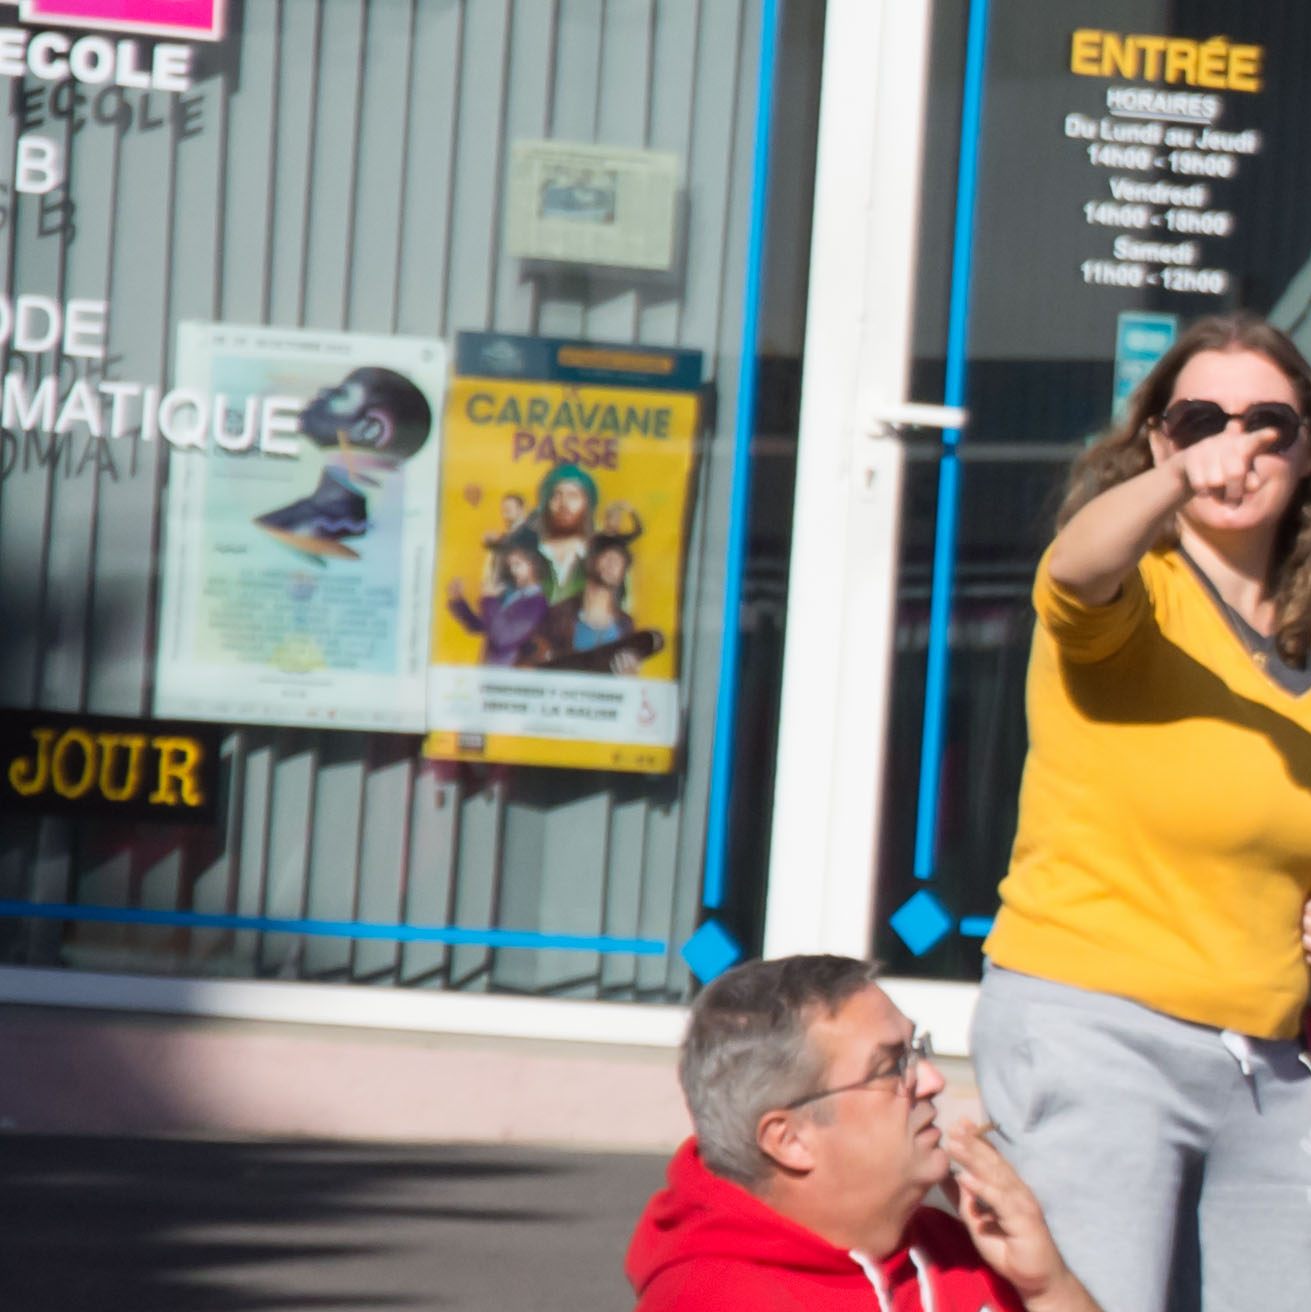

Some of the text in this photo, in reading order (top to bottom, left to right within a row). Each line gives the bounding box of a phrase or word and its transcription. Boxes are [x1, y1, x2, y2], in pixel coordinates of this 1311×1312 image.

[0, 27, 192, 92] ECOLE
[1071, 28, 1263, 93] ENTRÉE
[1106, 87, 1220, 119] HORAIRES
[1064, 113, 1259, 154] Du Lundi au Jeudi
[16, 136, 60, 194] B
[1087, 143, 1154, 171] 14h00
[1168, 150, 1236, 178] 19h00
[1110, 176, 1210, 207] Vendredi
[1083, 201, 1150, 229] 14h00
[1113, 235, 1199, 265] Samedi
[1080, 259, 1146, 288] 11h00
[1161, 267, 1230, 294] 12h00
[2, 372, 300, 456] MATIQUE
[466, 392, 672, 439] CARAVANE
[513, 431, 619, 471] PASSE
[8, 728, 203, 806] JOUR
